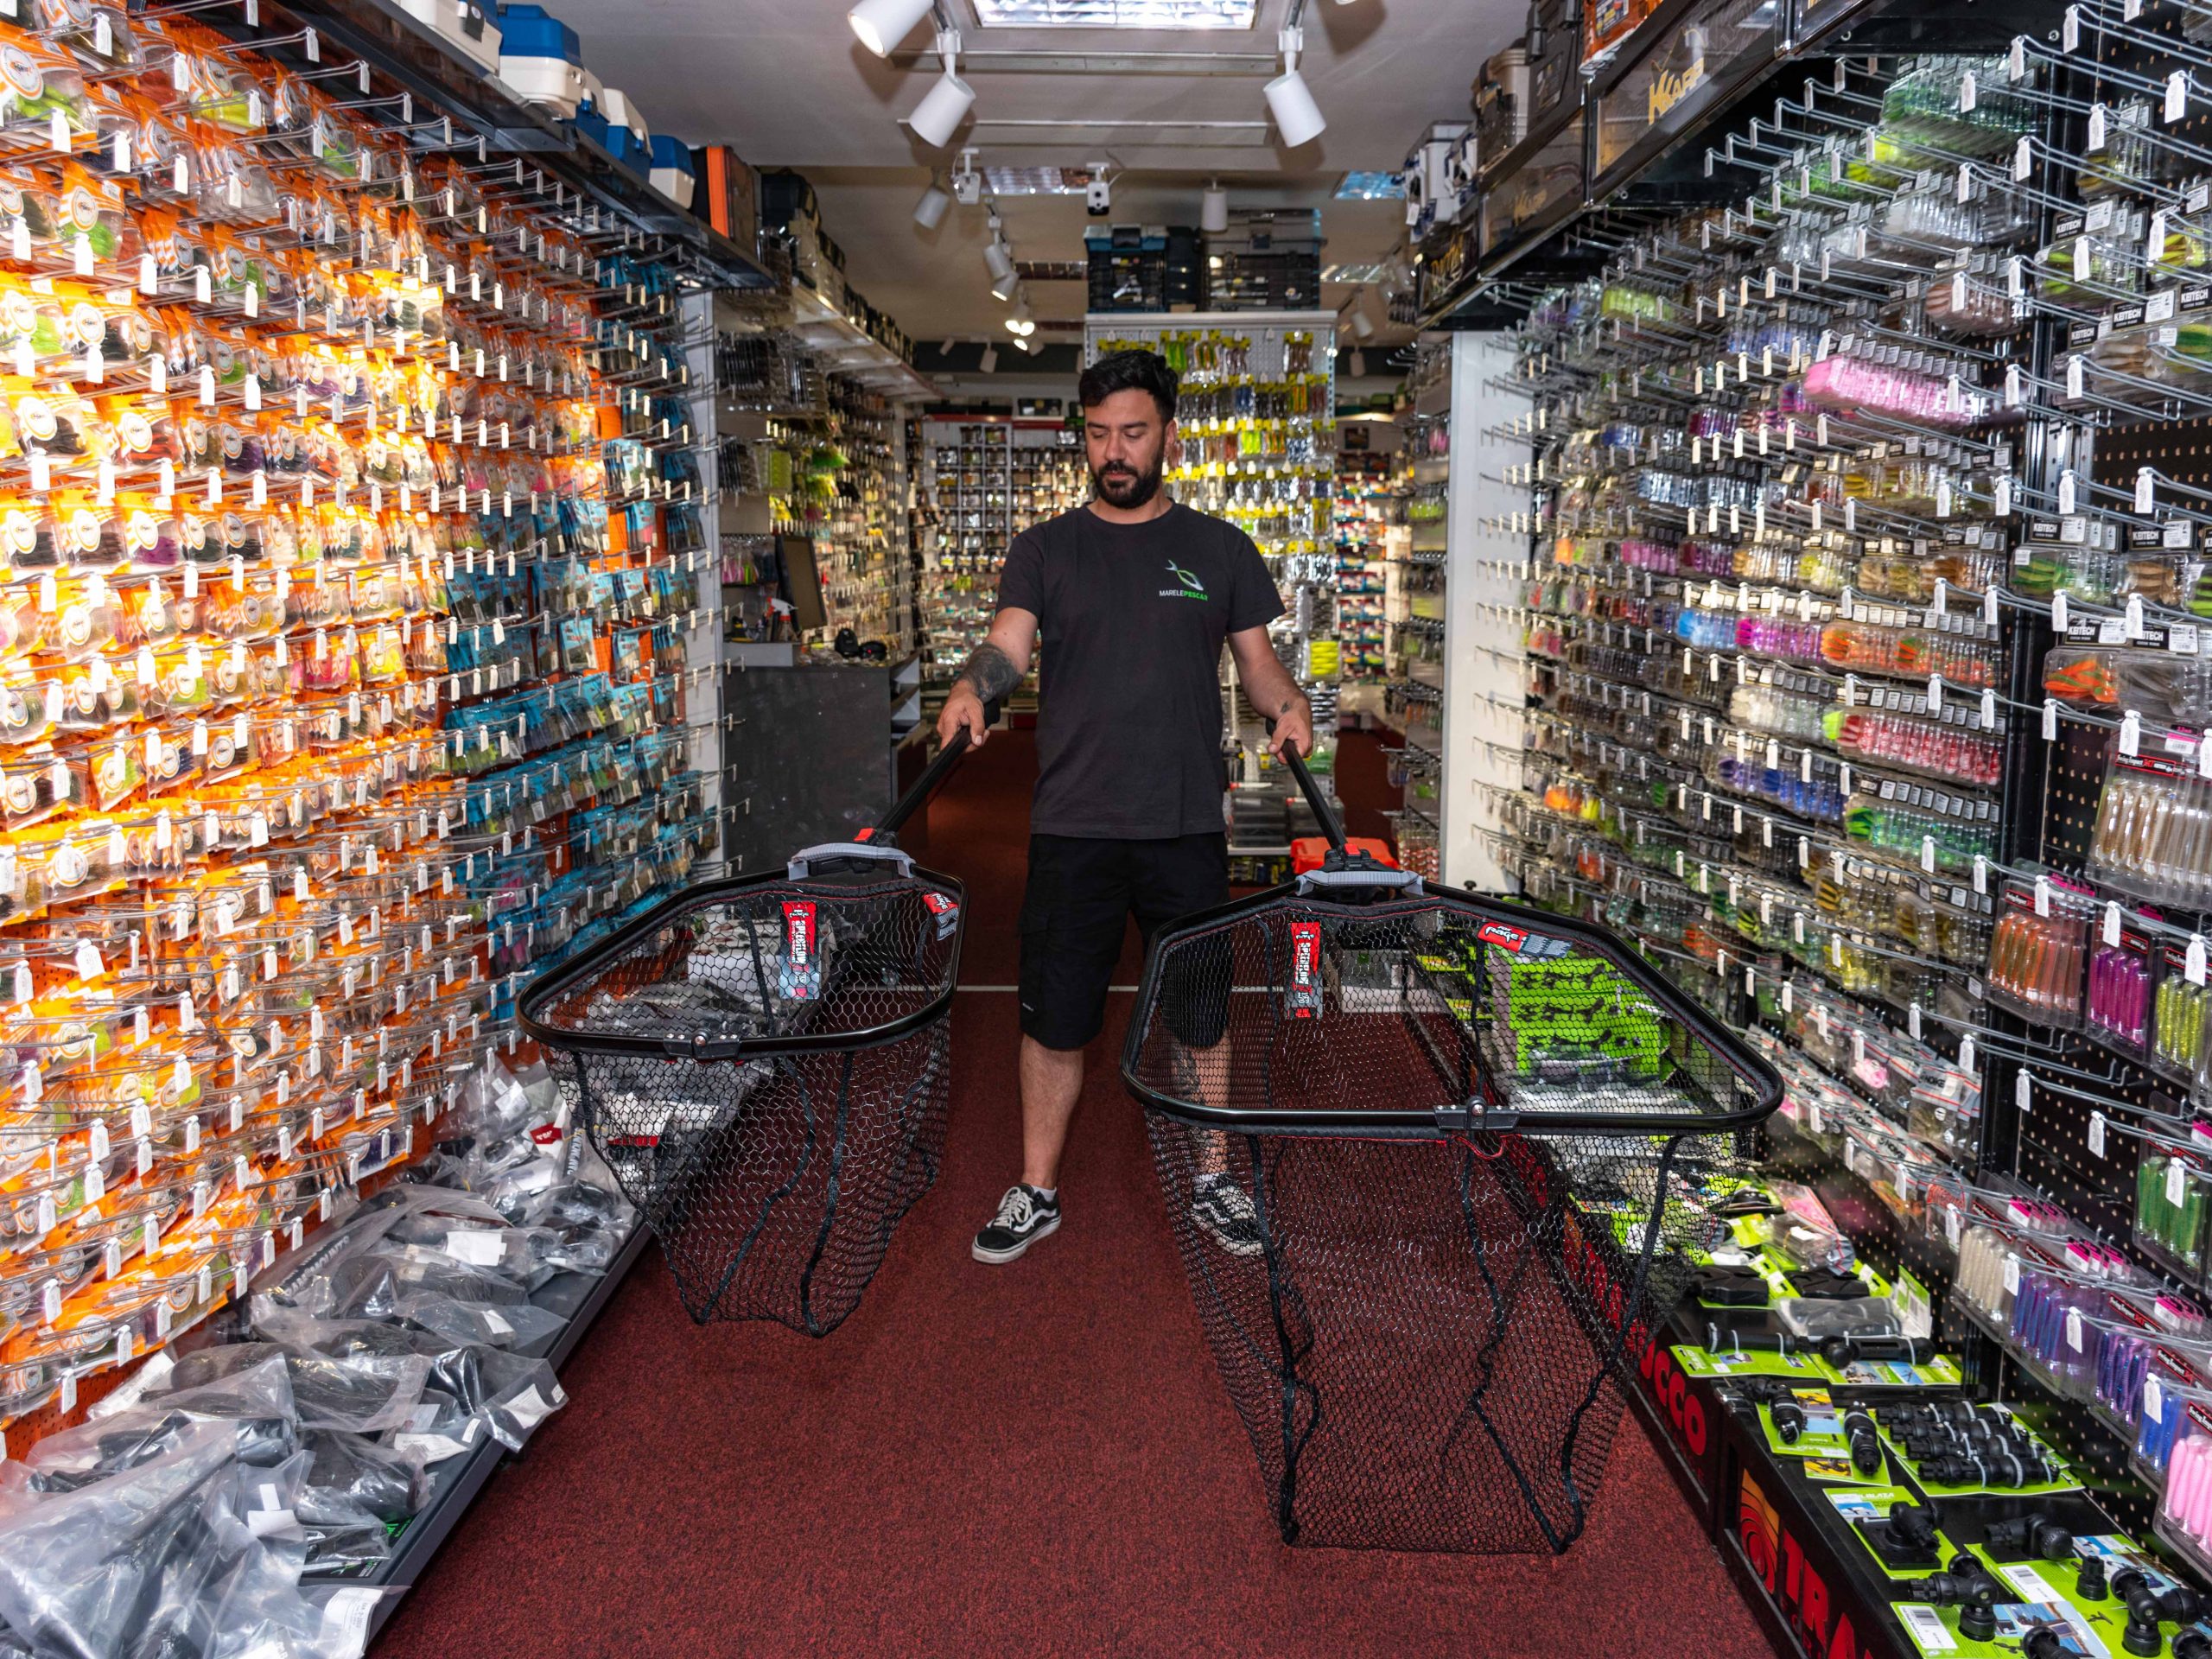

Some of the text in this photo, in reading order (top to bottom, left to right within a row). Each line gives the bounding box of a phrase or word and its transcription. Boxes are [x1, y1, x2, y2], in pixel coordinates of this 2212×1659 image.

[2056, 217, 2082, 233] KEITECH
[2180, 289, 2209, 304] KEITECH
[2113, 307, 2142, 323] KEITECH
[2071, 327, 2094, 340] KEITECH
[2033, 523, 2057, 533] KEITECH
[2133, 531, 2159, 541] KEITECH
[2068, 626, 2095, 636] KEITECH
